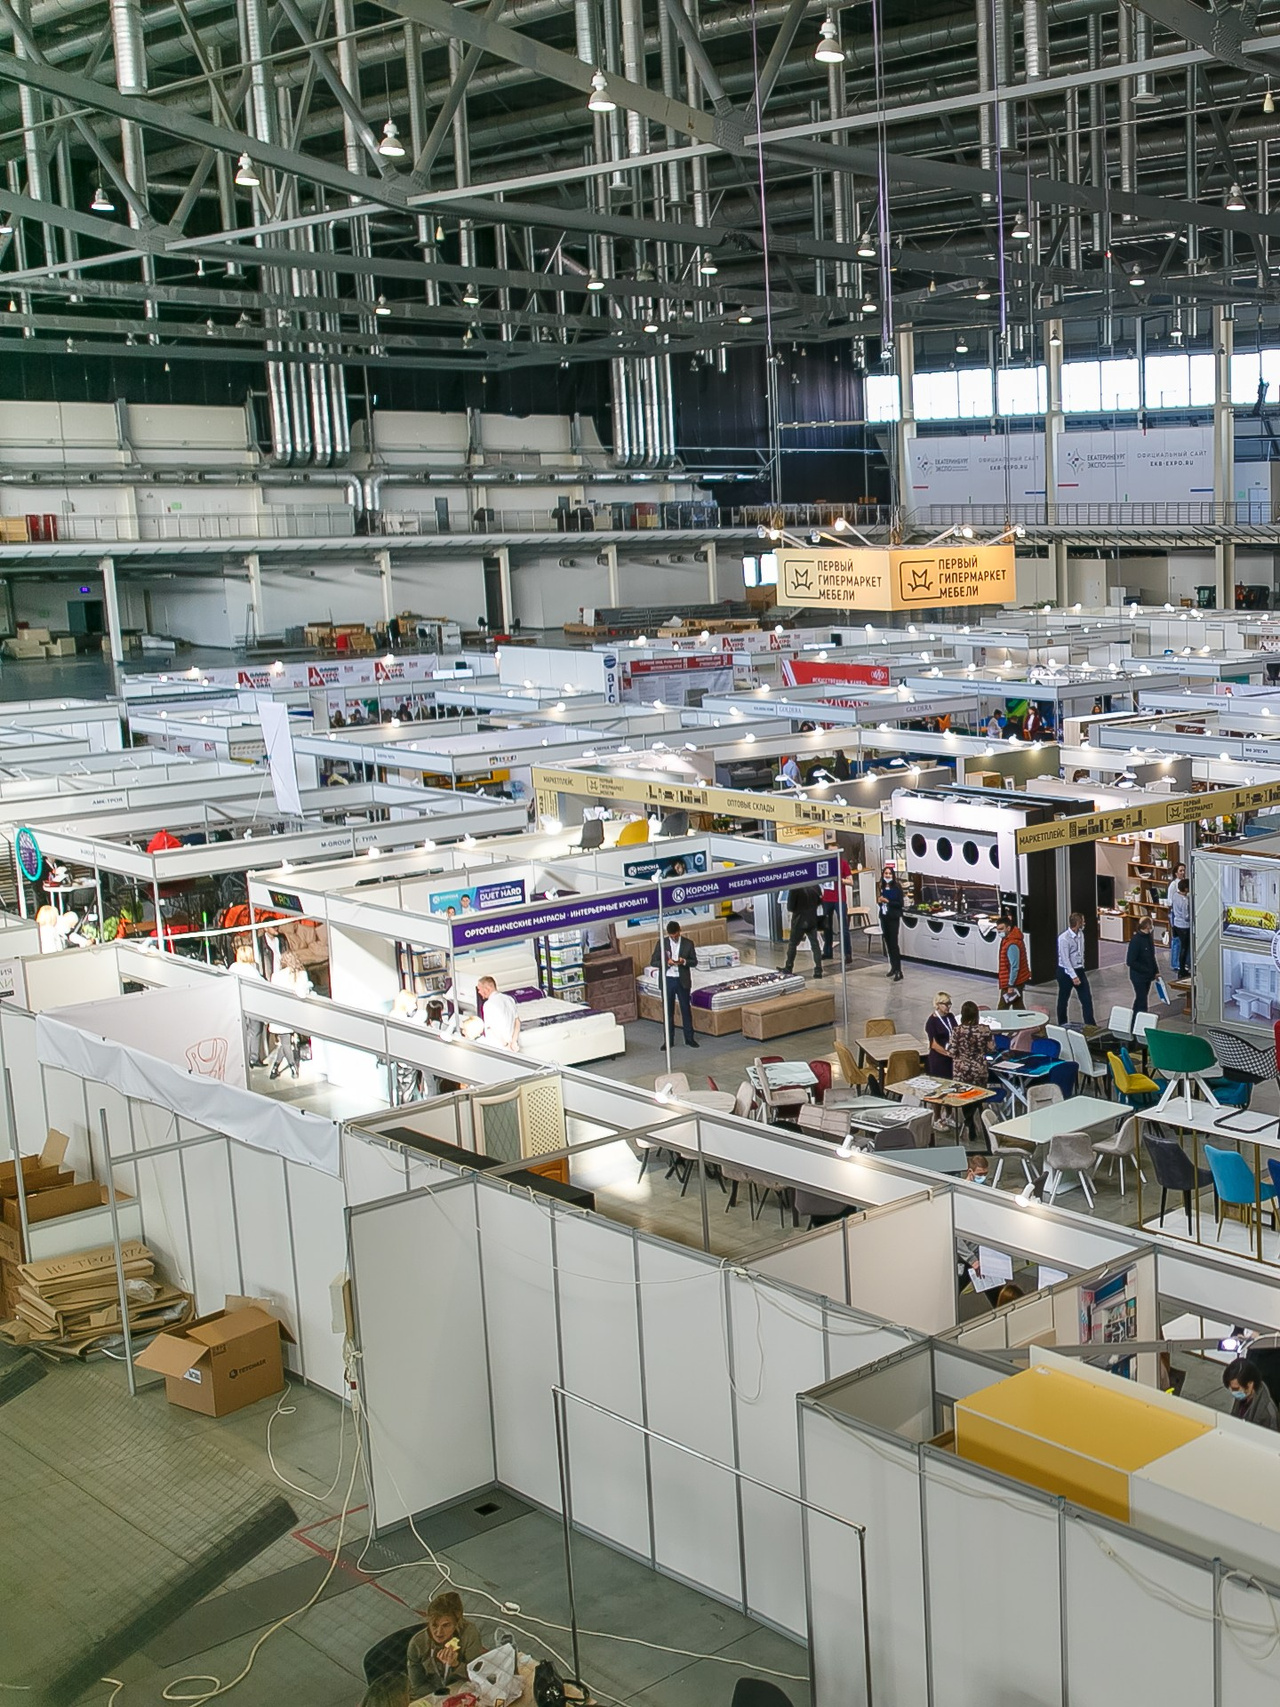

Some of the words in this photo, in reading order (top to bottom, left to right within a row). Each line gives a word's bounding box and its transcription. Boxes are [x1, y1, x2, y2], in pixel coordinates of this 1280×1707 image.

[817, 558, 854, 571] ПЕРВЫЙ
[938, 555, 978, 570] ПЕРВЫЙ
[818, 574, 882, 588] ГИПЕРМАРКЕТ
[939, 569, 1006, 584] ГИПЕРМАРКЕТ
[819, 589, 855, 600] МЕБЕЛИ
[940, 586, 979, 598] МЕБЕЛИ
[727, 798, 751, 810] ОПТОВЫЕ
[752, 801, 775, 813] СКЛАДЫ
[1019, 828, 1066, 846] МАРКЕТПЛЕЙС
[728, 880, 752, 889] МЕБЕЛЬ
[758, 873, 782, 883] ТОВАРЫ
[782, 871, 795, 880] ДЛЯ
[795, 869, 808, 877] СНА
[480, 892, 499, 901] DUET
[501, 888, 521, 897] HARD
[686, 883, 719, 895] КОРОНА
[464, 919, 532, 938] ОРТОПЕДИЧЕСКИЕ
[533, 913, 566, 925] МАТРАСЫ
[570, 902, 618, 917] ИНТЕРЬЕРНЫЕ
[619, 897, 649, 909] КРОВАТИ
